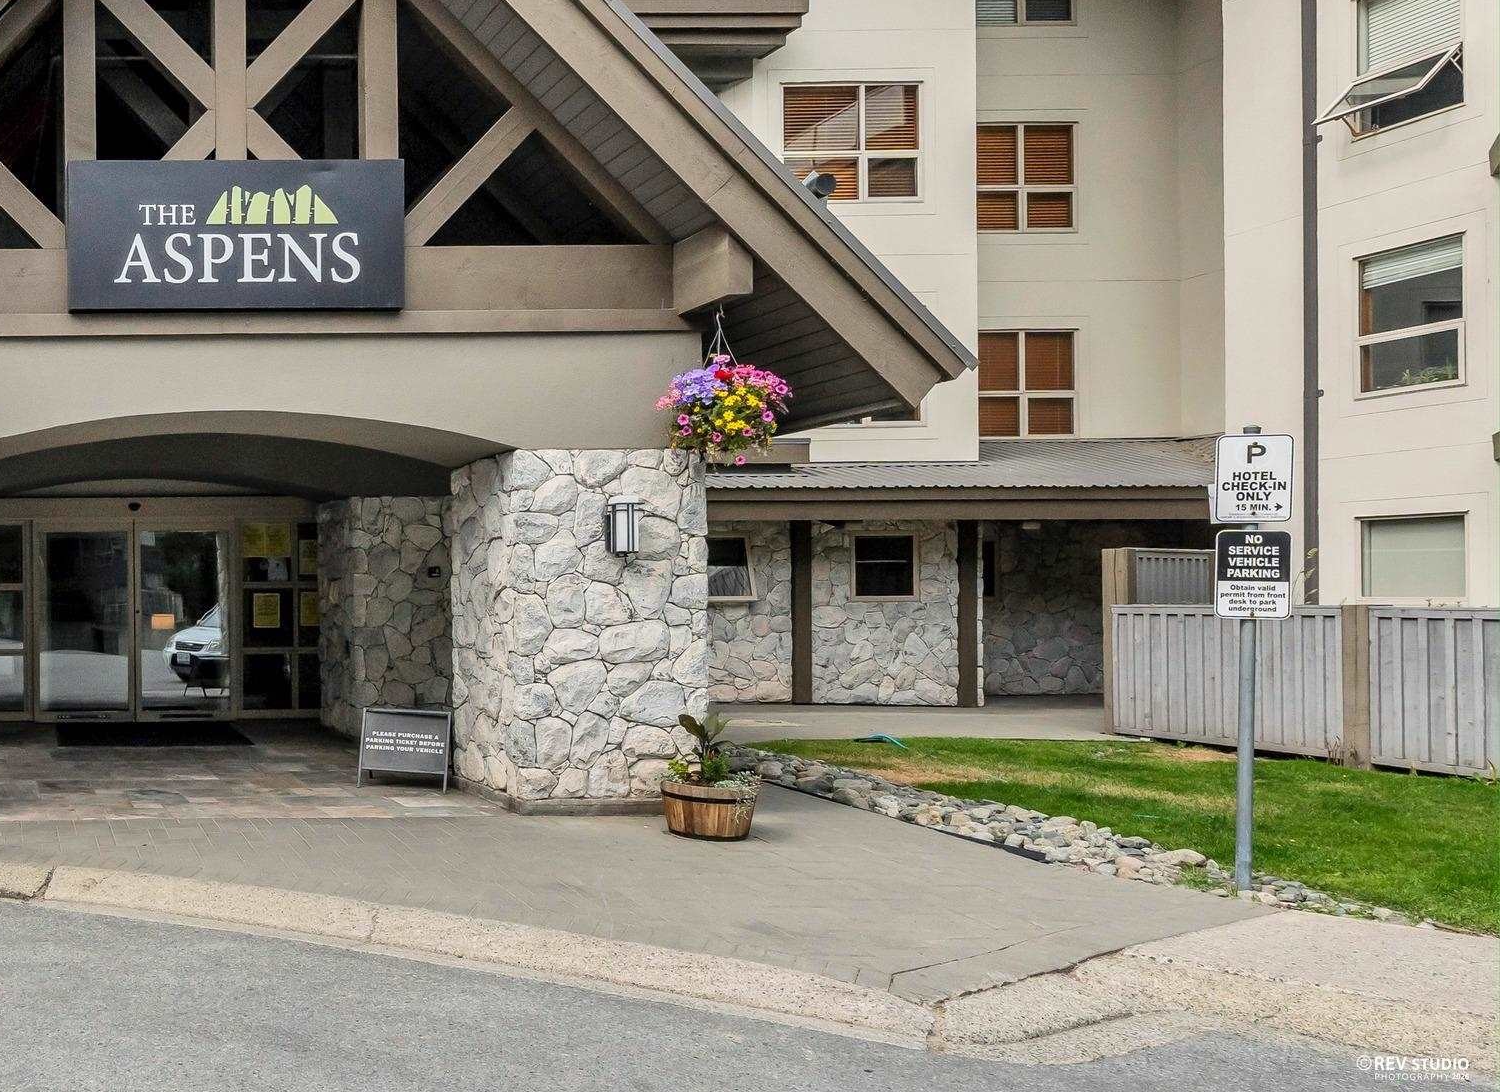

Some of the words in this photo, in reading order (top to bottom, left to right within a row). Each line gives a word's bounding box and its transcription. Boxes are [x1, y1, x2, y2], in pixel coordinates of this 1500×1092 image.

[138, 204, 196, 226] THE
[113, 232, 361, 284] ASPENS
[1246, 442, 1267, 464] P
[1232, 471, 1277, 481] HOTEL
[1222, 481, 1287, 491] CHECK-IN
[1236, 491, 1272, 501] ONLY
[1235, 504, 1247, 512] 15
[1250, 503, 1272, 511] MIN.
[1245, 534, 1263, 544] NO
[1228, 546, 1280, 556] SERVICE
[1228, 557, 1280, 567] VEHICLE
[1227, 568, 1280, 578] PARKING
[1230, 584, 1255, 592] Obtain
[398, 732, 433, 740] PURCHASE
[416, 747, 444, 755] VEHICLE
